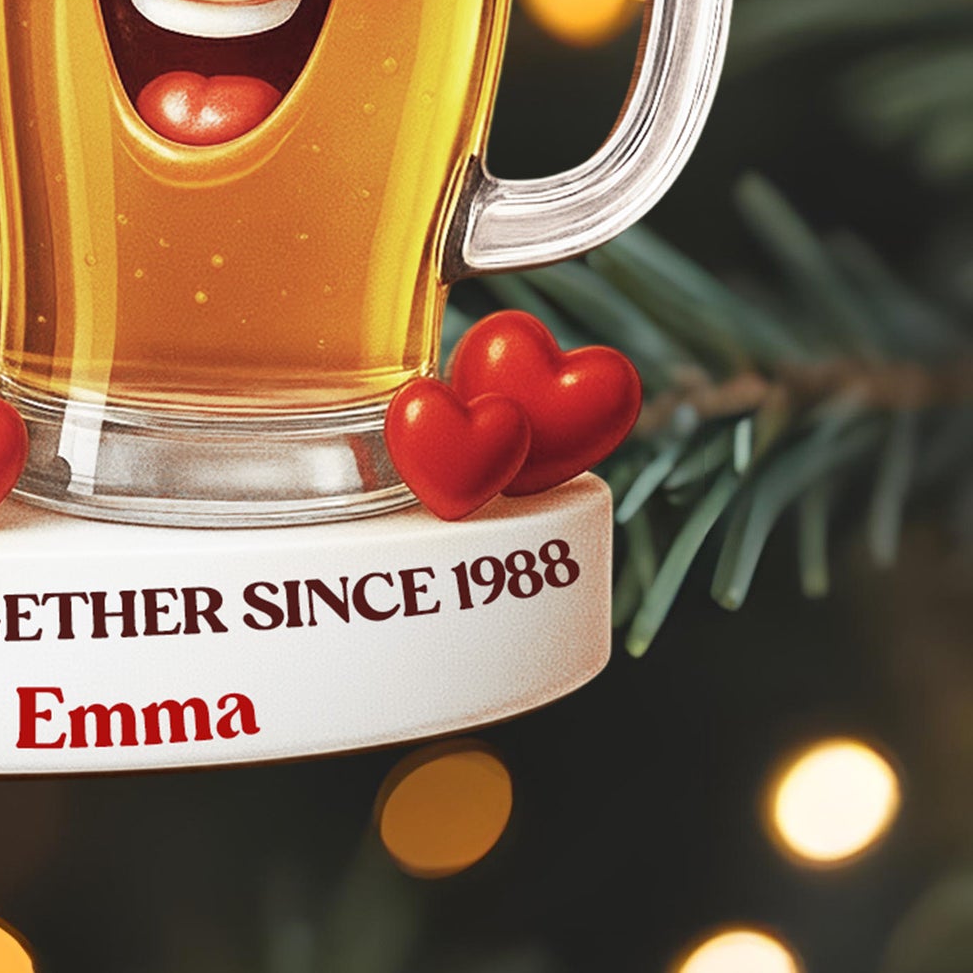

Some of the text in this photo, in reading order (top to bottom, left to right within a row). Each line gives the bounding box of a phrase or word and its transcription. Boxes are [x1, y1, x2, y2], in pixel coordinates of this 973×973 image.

[243, 567, 441, 631] SINCE
[451, 538, 581, 611] 1988
[15, 686, 261, 749] Emma
